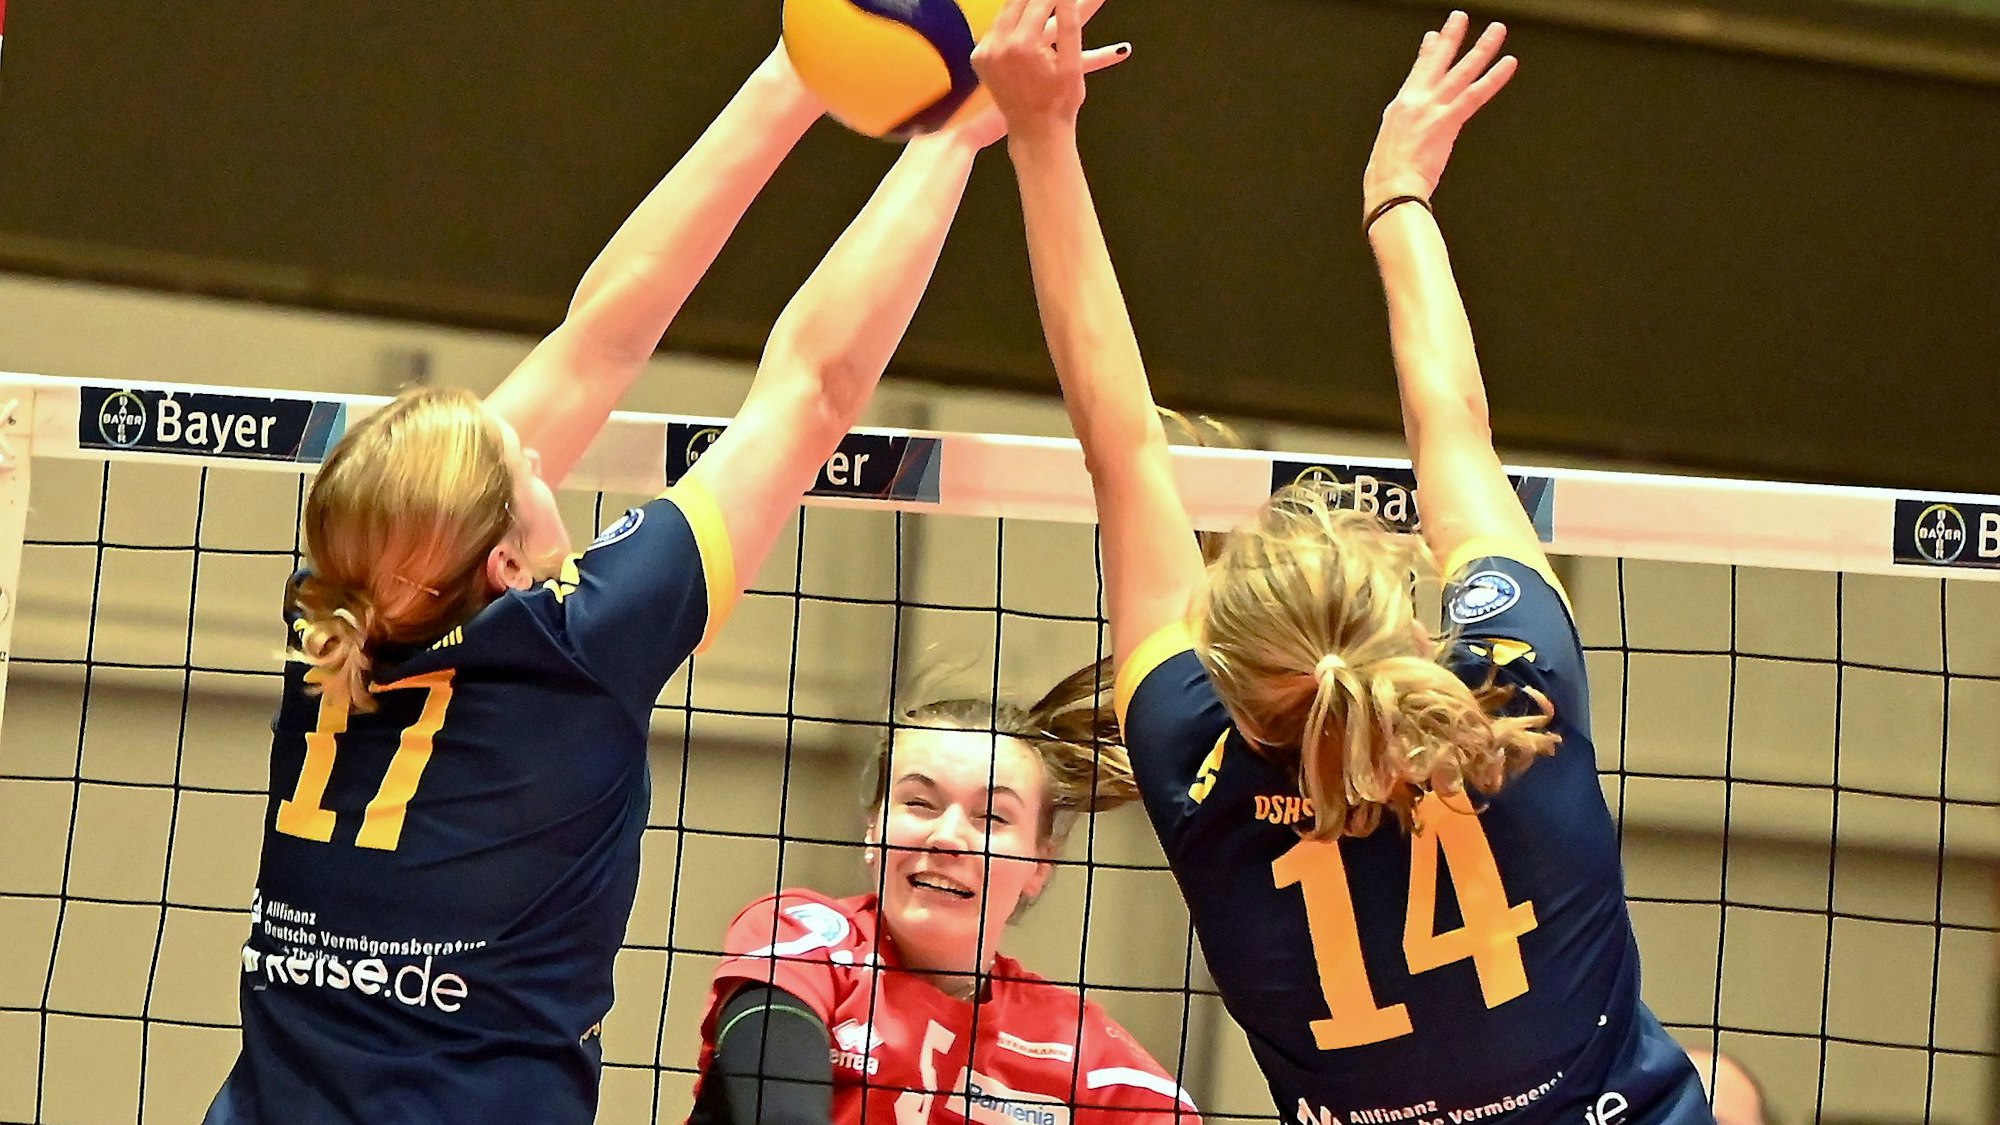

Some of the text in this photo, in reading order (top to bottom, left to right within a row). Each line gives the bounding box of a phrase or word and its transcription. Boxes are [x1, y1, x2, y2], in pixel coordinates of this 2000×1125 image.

[156, 399, 277, 454] Bayer
[826, 450, 870, 487] er
[275, 667, 456, 851] 17
[266, 900, 317, 926] Allfinanz
[1271, 787, 1538, 1050] 14
[264, 920, 317, 946] Deutsche
[1349, 1100, 1439, 1125] Allfinanz
